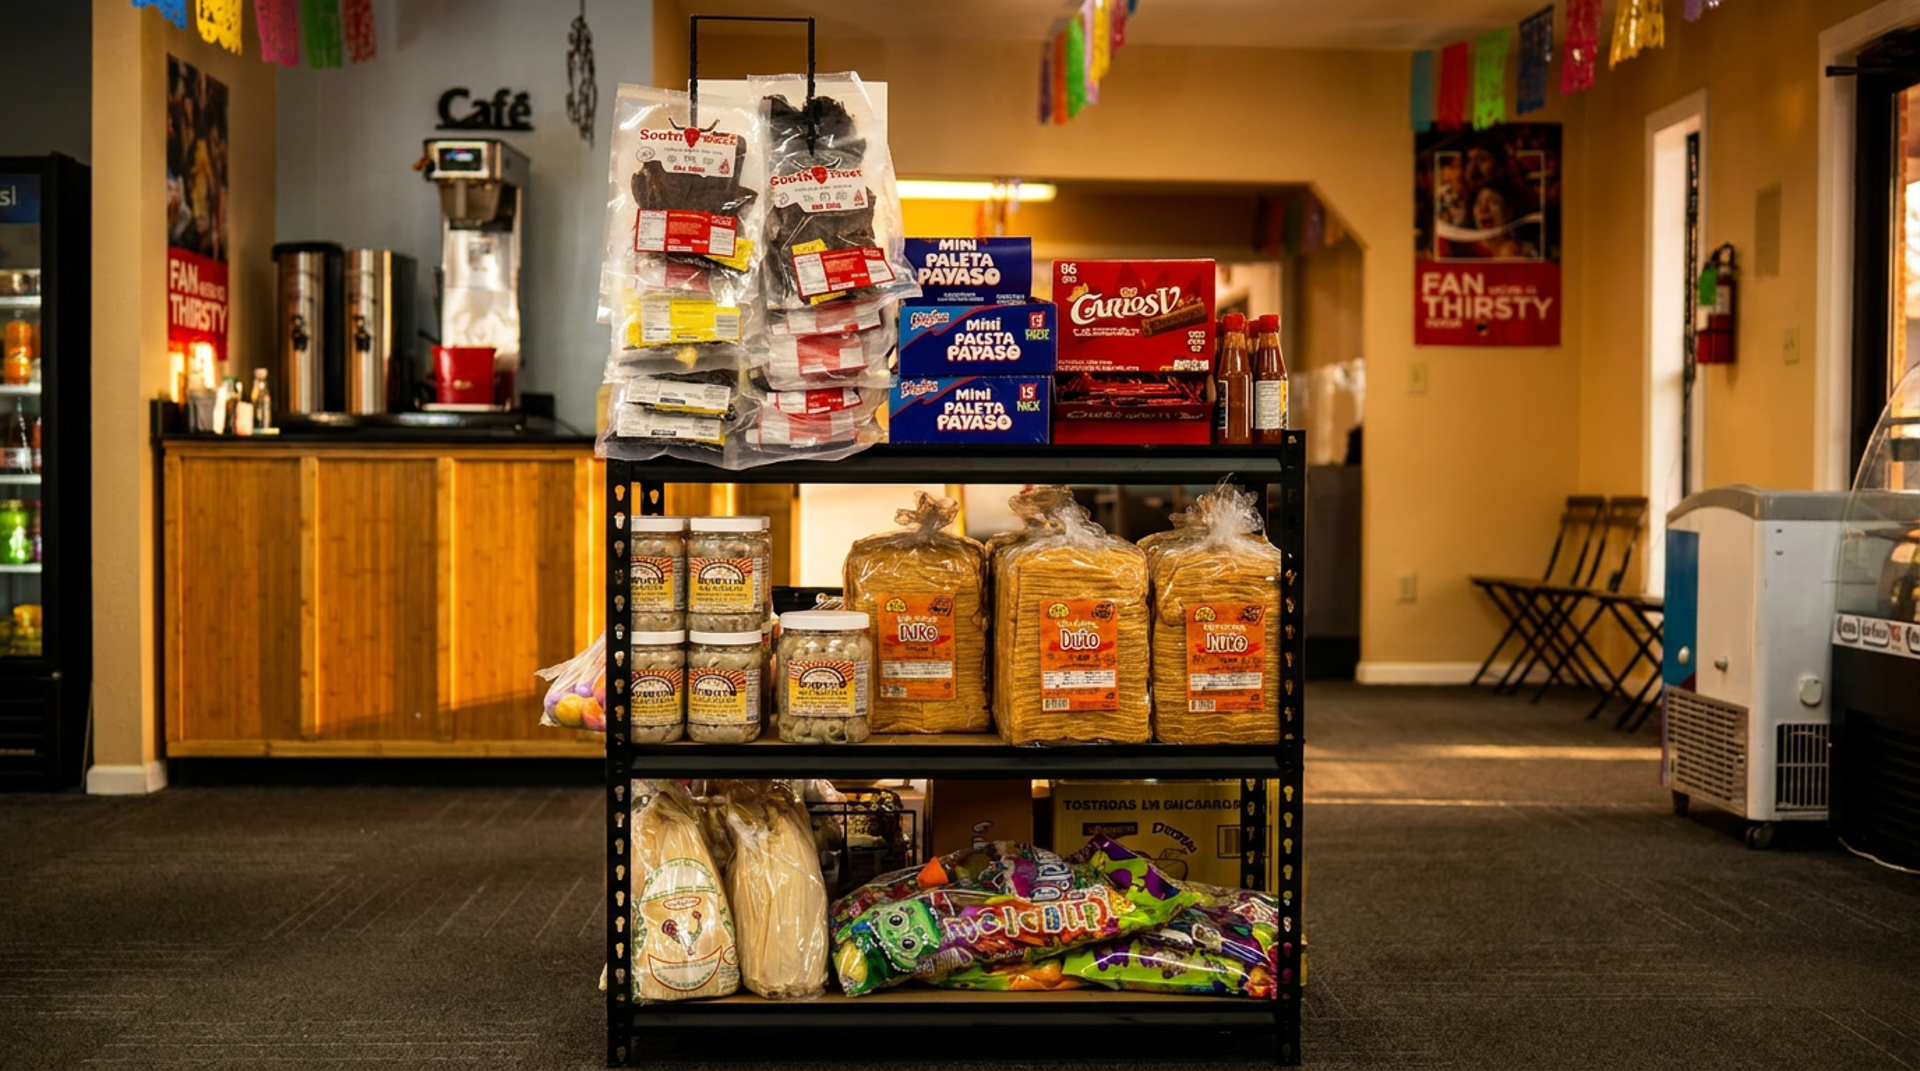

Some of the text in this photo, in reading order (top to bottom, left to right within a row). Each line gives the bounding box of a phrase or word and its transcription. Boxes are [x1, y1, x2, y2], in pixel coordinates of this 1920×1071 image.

[438, 87, 531, 130] Café
[939, 239, 977, 251] MINI
[925, 253, 995, 267] PALETA
[170, 259, 198, 295] FAN
[918, 268, 1001, 286] PAYASO
[1422, 272, 1485, 295] FAN
[170, 293, 228, 334] THIRSTY
[1422, 296, 1553, 320] THIRSTY
[944, 402, 1006, 415] PALETA
[937, 415, 1013, 431] PAYASO
[1063, 799, 1137, 811] TOSTADAS
